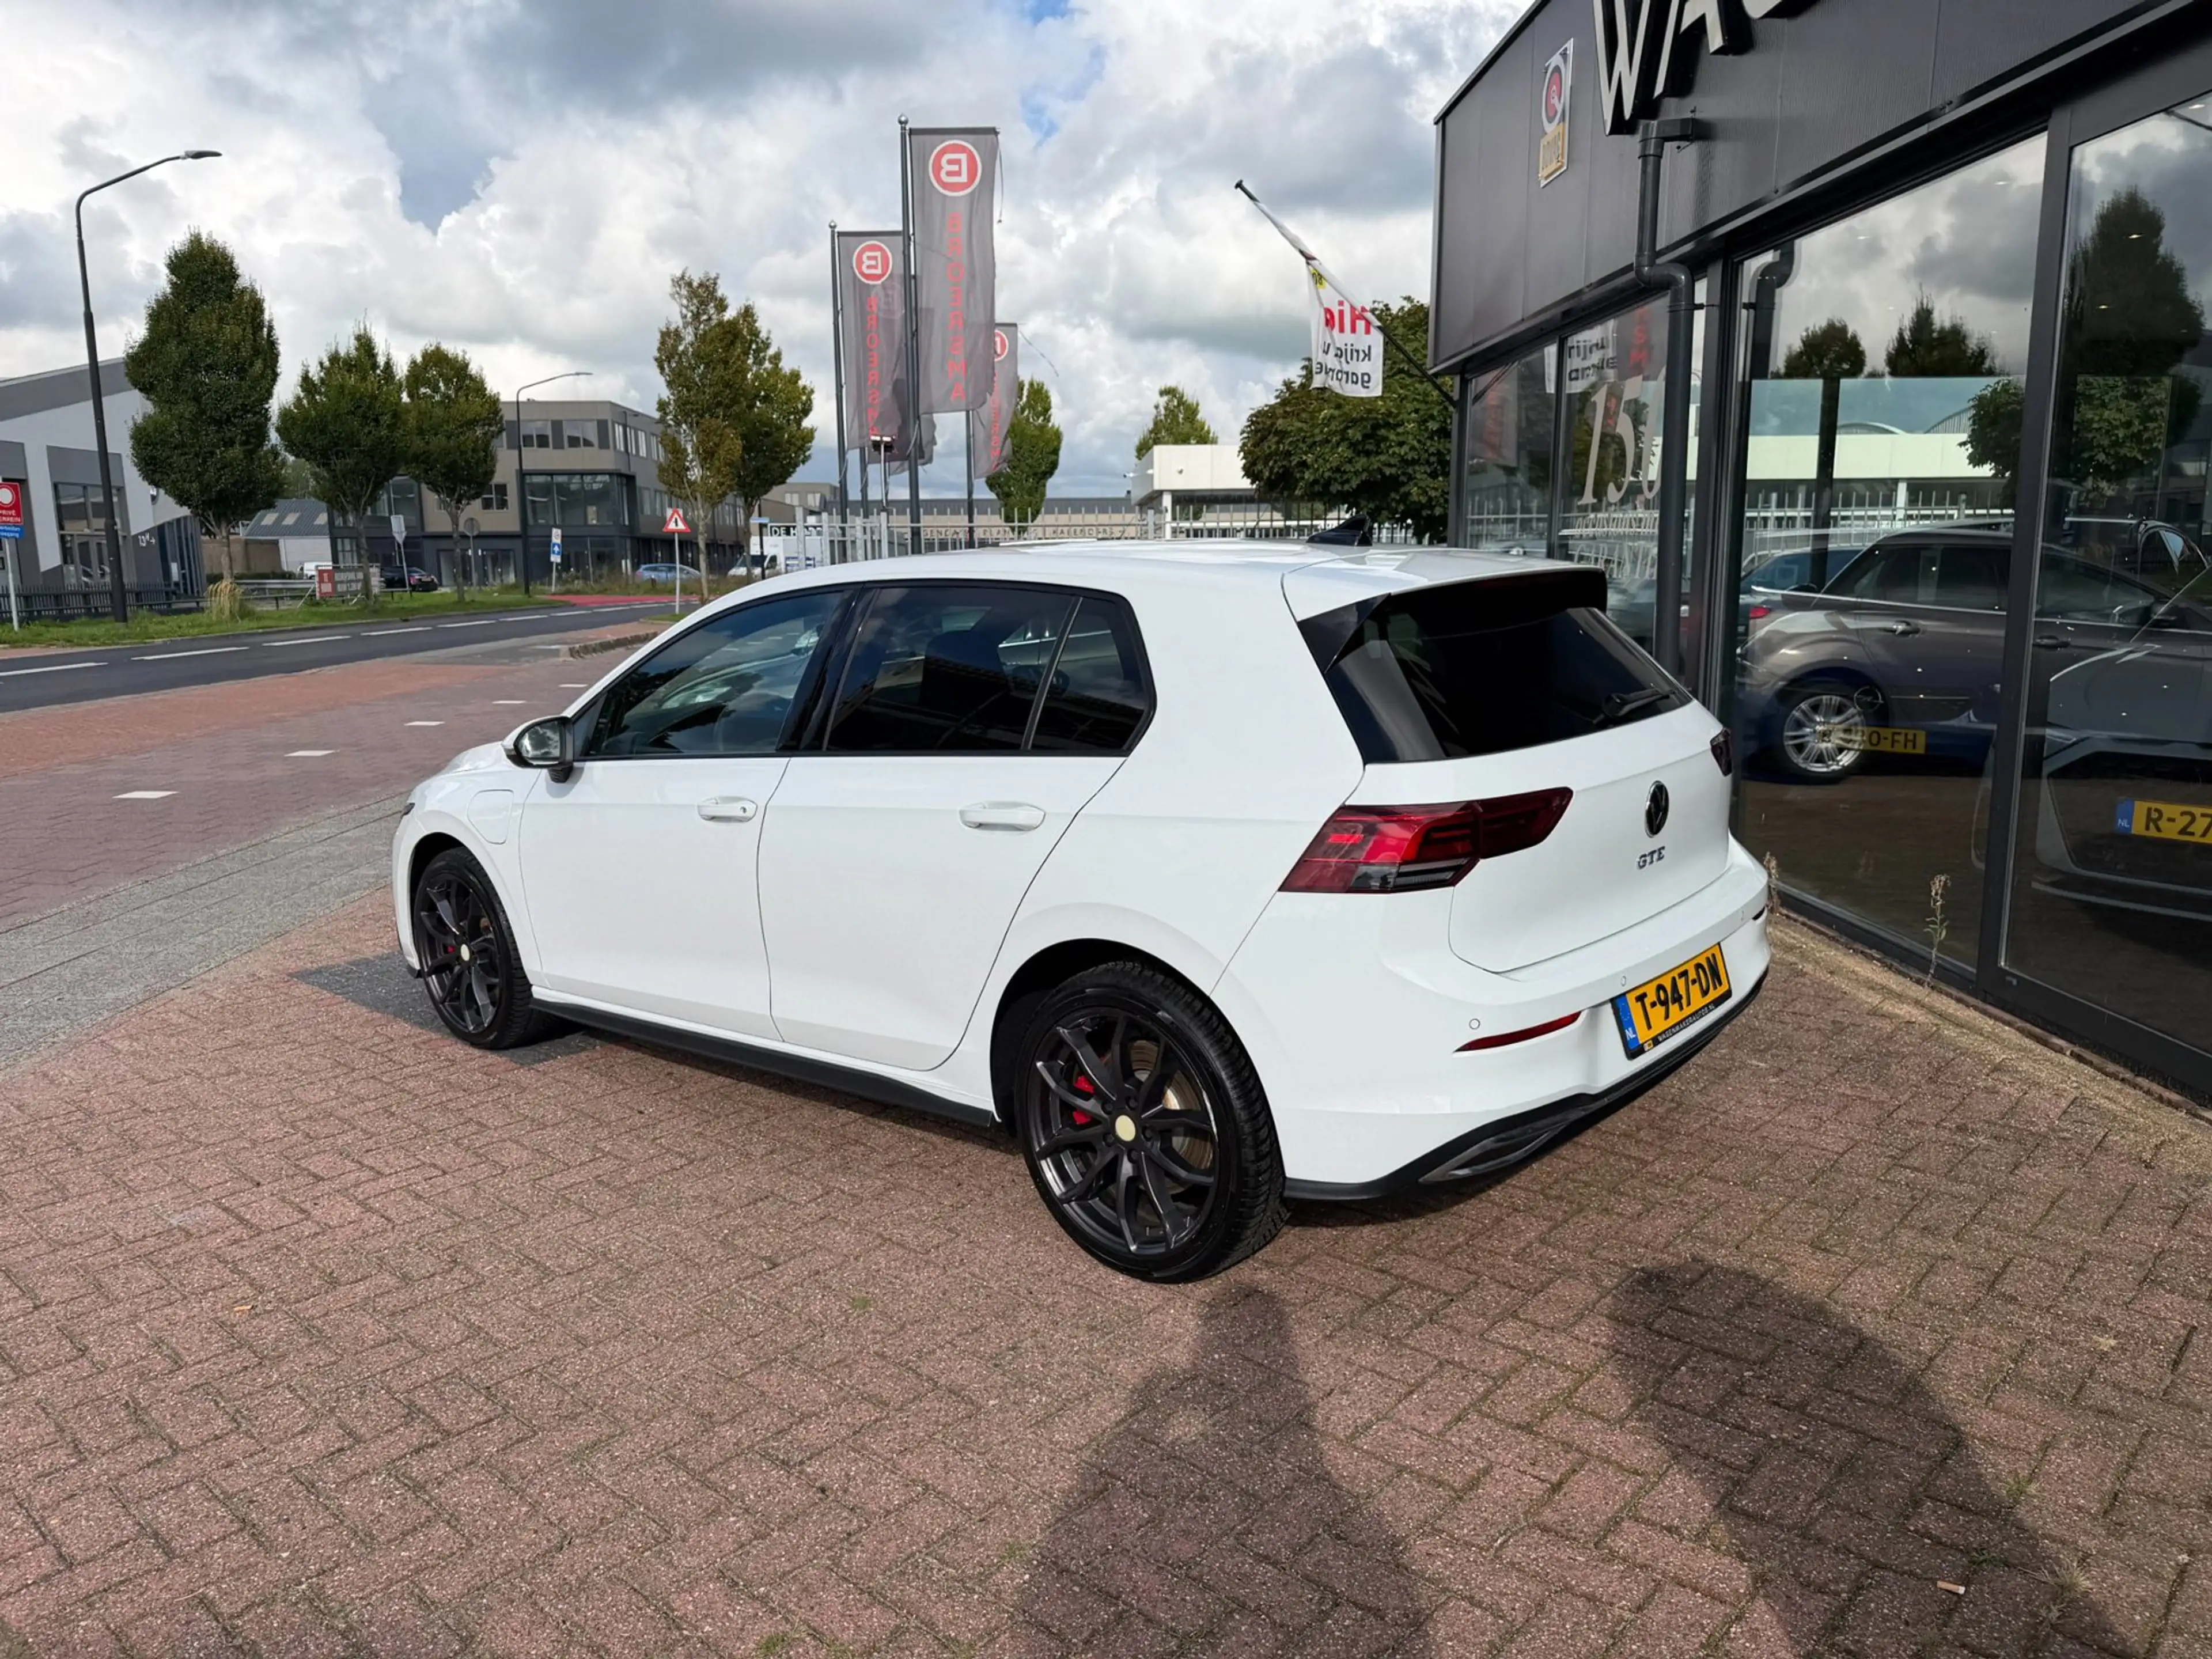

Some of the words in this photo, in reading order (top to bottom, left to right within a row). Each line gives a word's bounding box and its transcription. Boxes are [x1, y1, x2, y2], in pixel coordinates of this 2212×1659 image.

[1637, 846, 1666, 870] GTE
[1625, 1027, 1637, 1040] NL
[1635, 952, 1724, 1031] T-947-DN
